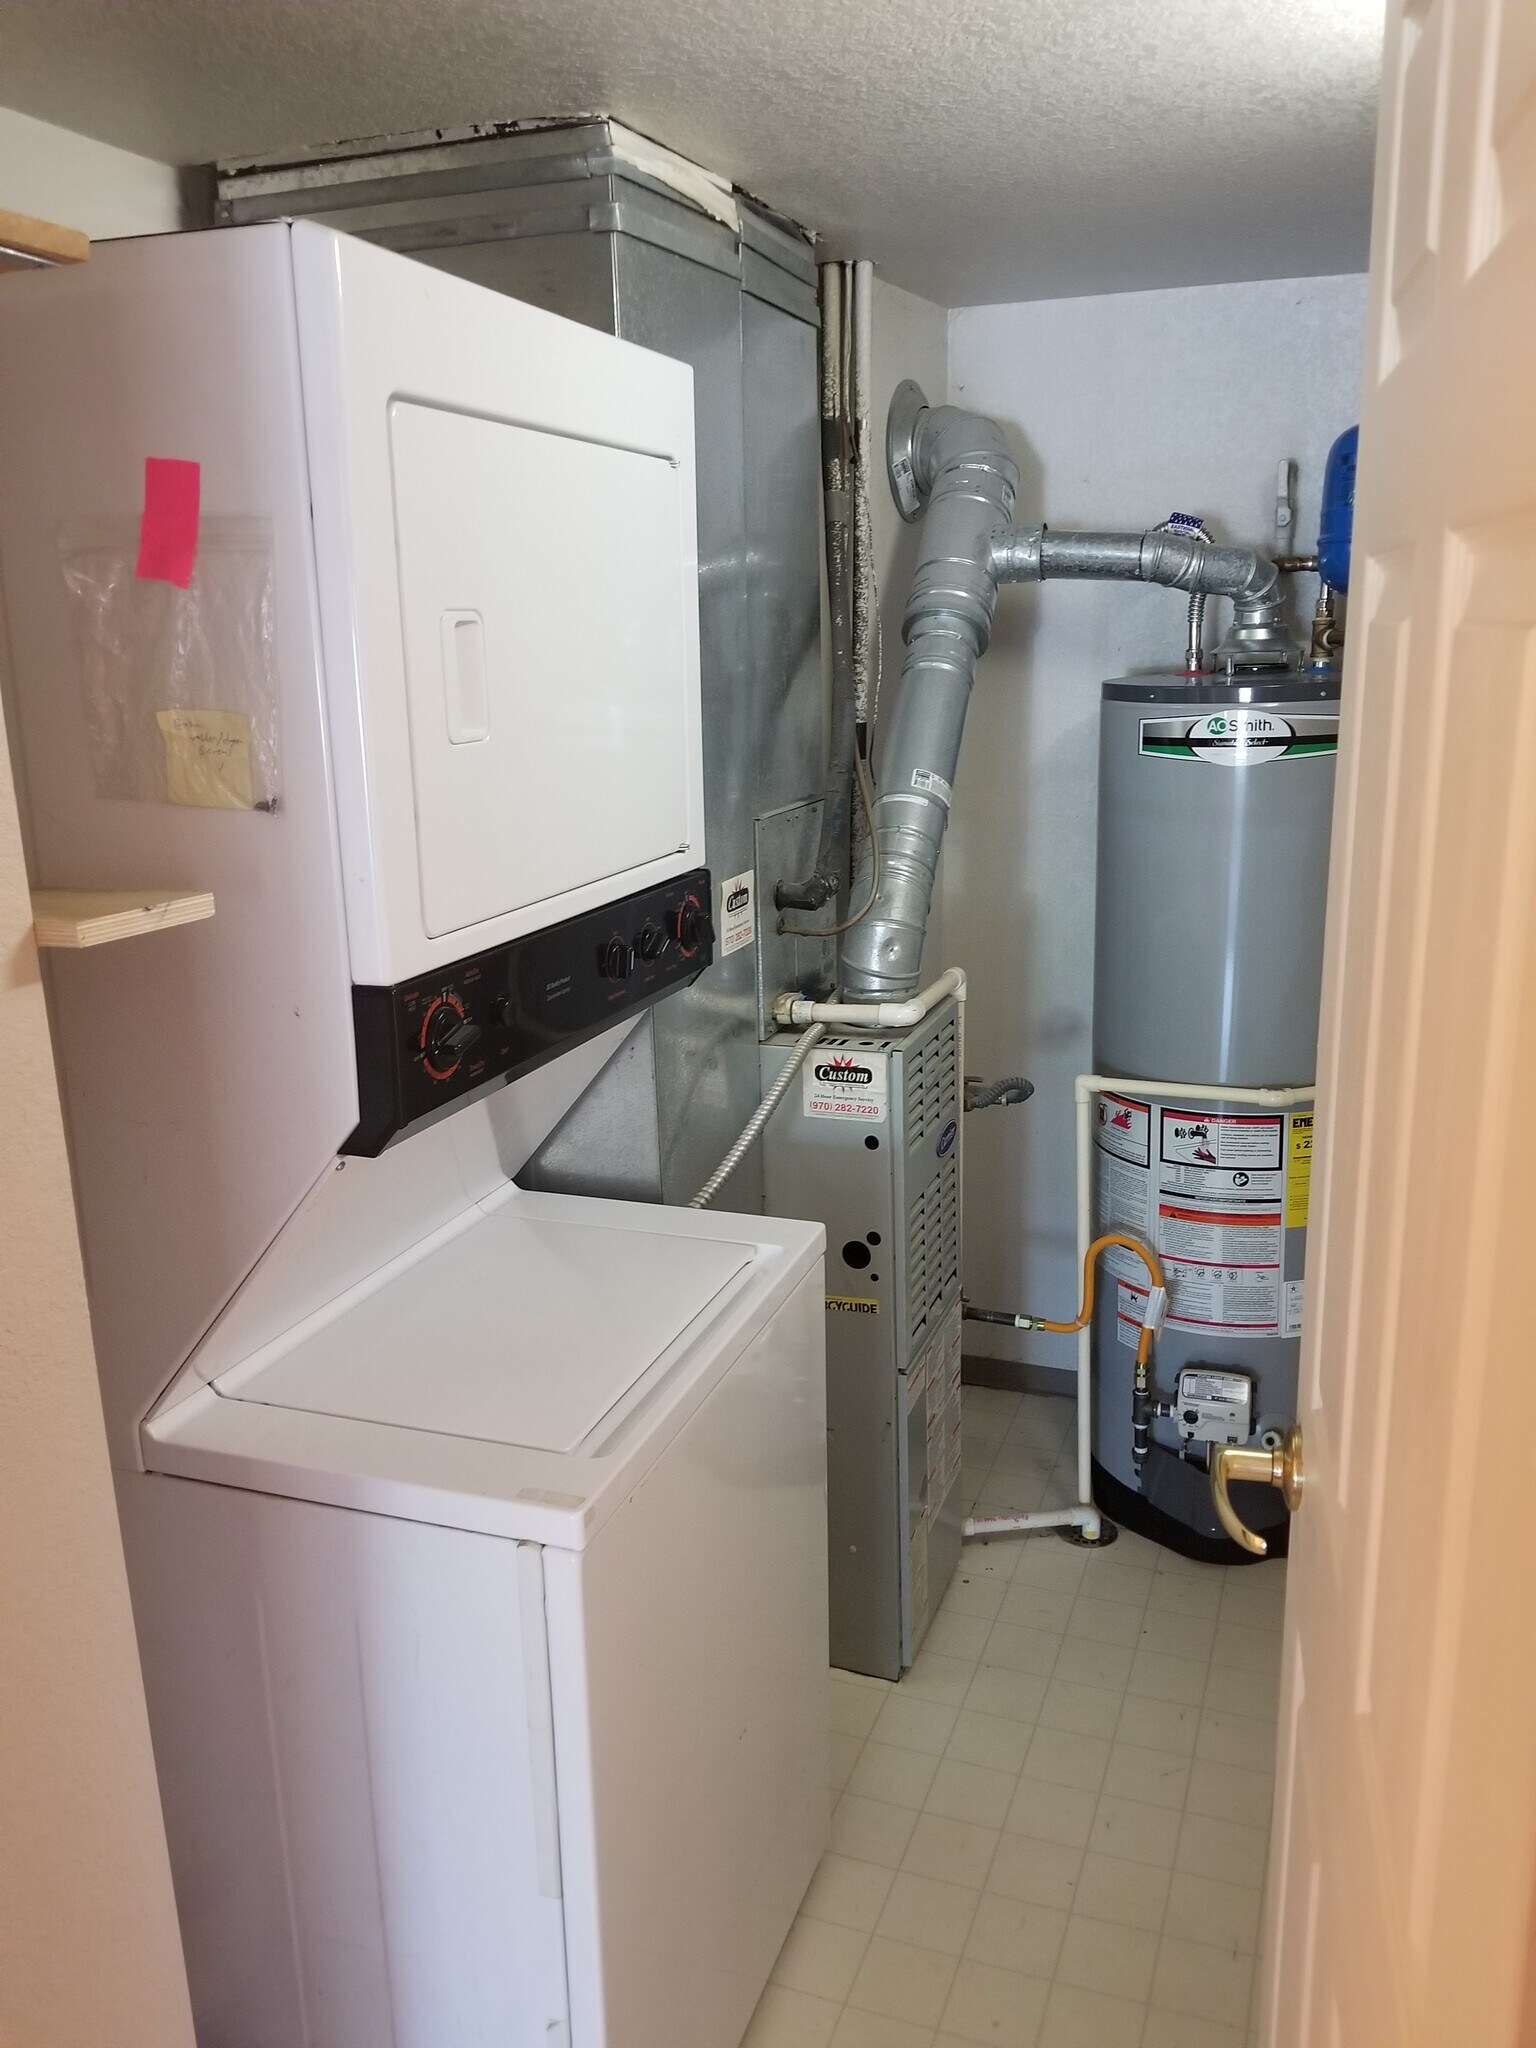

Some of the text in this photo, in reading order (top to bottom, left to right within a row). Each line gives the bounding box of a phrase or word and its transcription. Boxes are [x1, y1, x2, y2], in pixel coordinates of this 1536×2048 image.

[820, 1066, 868, 1083] Custom
[810, 1100, 879, 1114] (970) 282-7220
